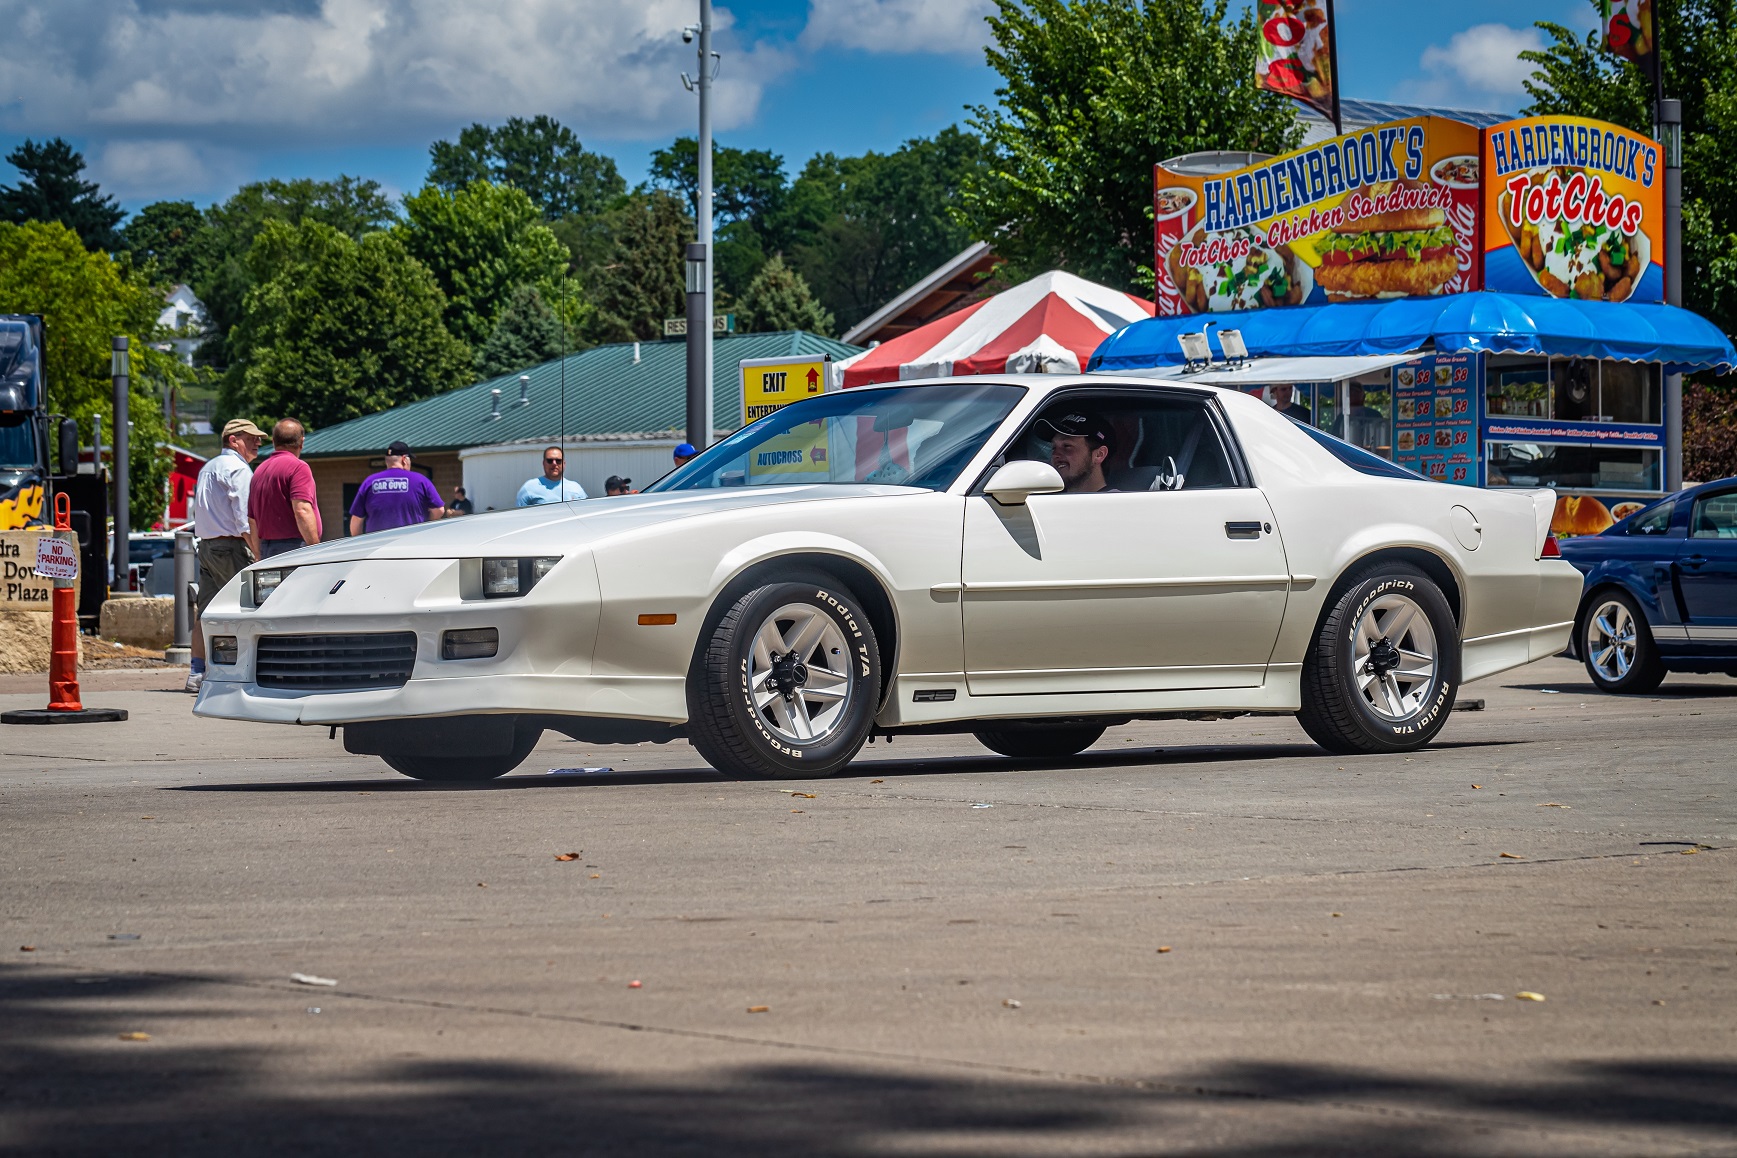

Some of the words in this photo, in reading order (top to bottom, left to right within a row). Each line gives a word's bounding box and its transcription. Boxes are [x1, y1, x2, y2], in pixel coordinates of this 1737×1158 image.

[1491, 124, 1657, 188] HARDENBROOK'S
[1204, 125, 1425, 234] HARDENBROOK'S
[1506, 172, 1643, 236] TotChos
[1179, 233, 1250, 268] TotChos
[1266, 206, 1344, 249] Chicken
[1348, 183, 1453, 222] Sandwich
[762, 371, 788, 393] EXIT
[1416, 369, 1431, 384] $8
[1454, 367, 1468, 382] $8
[1416, 401, 1431, 415] $8
[1454, 399, 1468, 414] $8
[1416, 431, 1431, 446] $8
[1454, 430, 1468, 445] $8
[757, 449, 803, 466] AUTOCROSS
[1430, 463, 1446, 476] $12
[1453, 467, 1467, 480] $3
[373, 482, 387, 491] CAR
[388, 481, 407, 490] GUYS
[52, 545, 63, 556] NO
[41, 554, 74, 567] PARKING
[55, 566, 68, 574] Lane
[6, 582, 49, 601] Plaza
[1349, 579, 1415, 642] BFGoodrich
[816, 590, 863, 638] Radial
[858, 643, 871, 678] T/A
[740, 658, 803, 758] BFGoodrich
[1417, 681, 1451, 731] Radial
[1392, 726, 1415, 735] T/A
